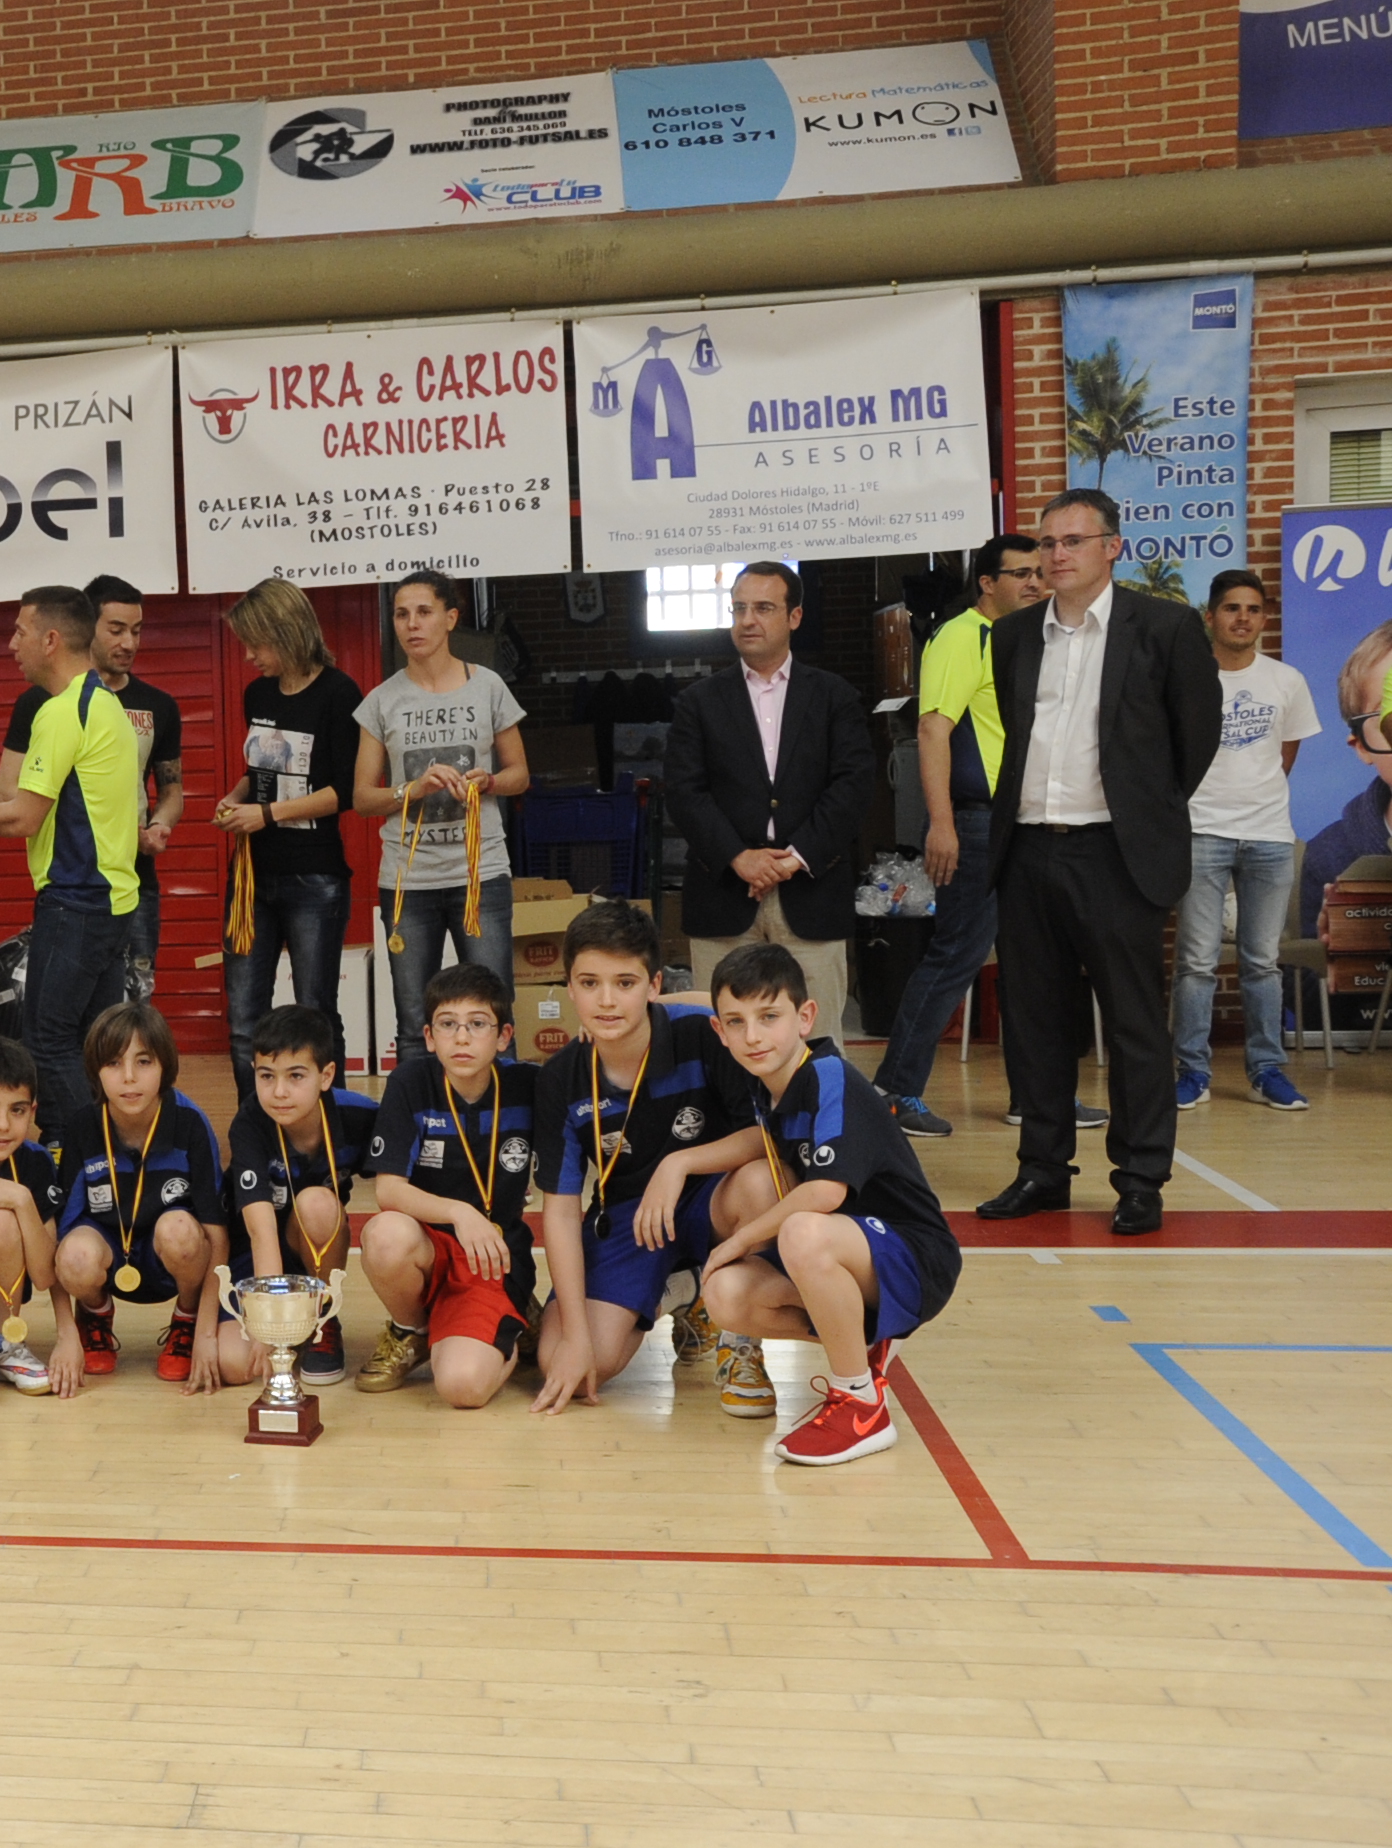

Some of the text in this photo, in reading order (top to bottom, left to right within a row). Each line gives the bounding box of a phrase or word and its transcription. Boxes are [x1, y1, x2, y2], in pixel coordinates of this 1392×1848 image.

[1286, 6, 1392, 49] MENÚ
[444, 92, 571, 113] PHOTOGRAPHY
[798, 79, 989, 104] Lectura Matemáticas
[472, 116, 507, 126] DANI
[647, 101, 747, 119] Móstoles
[804, 100, 999, 134] KUMON
[652, 116, 746, 134] Carlos V
[409, 127, 609, 155] WWW.FOTO-FUTSAL.ES
[624, 129, 777, 152] 610 848 371
[828, 132, 937, 148] www.kumon.es
[159, 198, 236, 213] BRAVO
[506, 184, 603, 205] CLUB
[696, 338, 714, 368] G
[269, 346, 559, 410] IRRA & CARLOS
[592, 380, 619, 410] M
[1173, 395, 1236, 418] Este
[13, 390, 133, 432] PRIZÁN
[630, 358, 697, 480] A
[748, 384, 948, 434] Albalex MG
[323, 412, 506, 458] CARNICERIA
[1126, 432, 1236, 455] Verano
[754, 437, 951, 468] ASESORÍA
[1157, 464, 1235, 487] Pinta
[198, 477, 551, 513] GALERIA LAS LOMAS Puesto 28
[687, 490, 728, 504] Ciudad
[732, 488, 777, 501] Dolores
[780, 485, 829, 498] Hidalgo,
[833, 484, 847, 494] 11
[209, 516, 232, 531] C/
[307, 510, 332, 524] 38
[408, 497, 541, 517] 916461068
[708, 499, 860, 519] 28931 Móstoles (Madrid)
[1119, 500, 1234, 522] ien con
[310, 521, 438, 543] (MOSTOLES)
[645, 529, 659, 540] 91
[663, 528, 685, 539] 614
[688, 527, 703, 537] 07
[707, 526, 722, 536] 55
[733, 524, 756, 535] Fax:
[759, 522, 773, 533] 91
[777, 521, 799, 532] 614
[803, 519, 817, 530] 07
[821, 518, 836, 529] 55
[848, 516, 885, 528] Móvil:
[889, 513, 911, 524] 627
[915, 512, 937, 523] 511
[941, 510, 965, 521] 499
[655, 531, 917, 557] asesoria@albalexmg.es www.albalexmg.es
[273, 554, 480, 579] Servicio a domicilio
[125, 711, 153, 730] ONES
[402, 705, 476, 728] THERE'S
[405, 727, 478, 746] BEAUTY IN
[538, 1032, 565, 1043] FRIT
